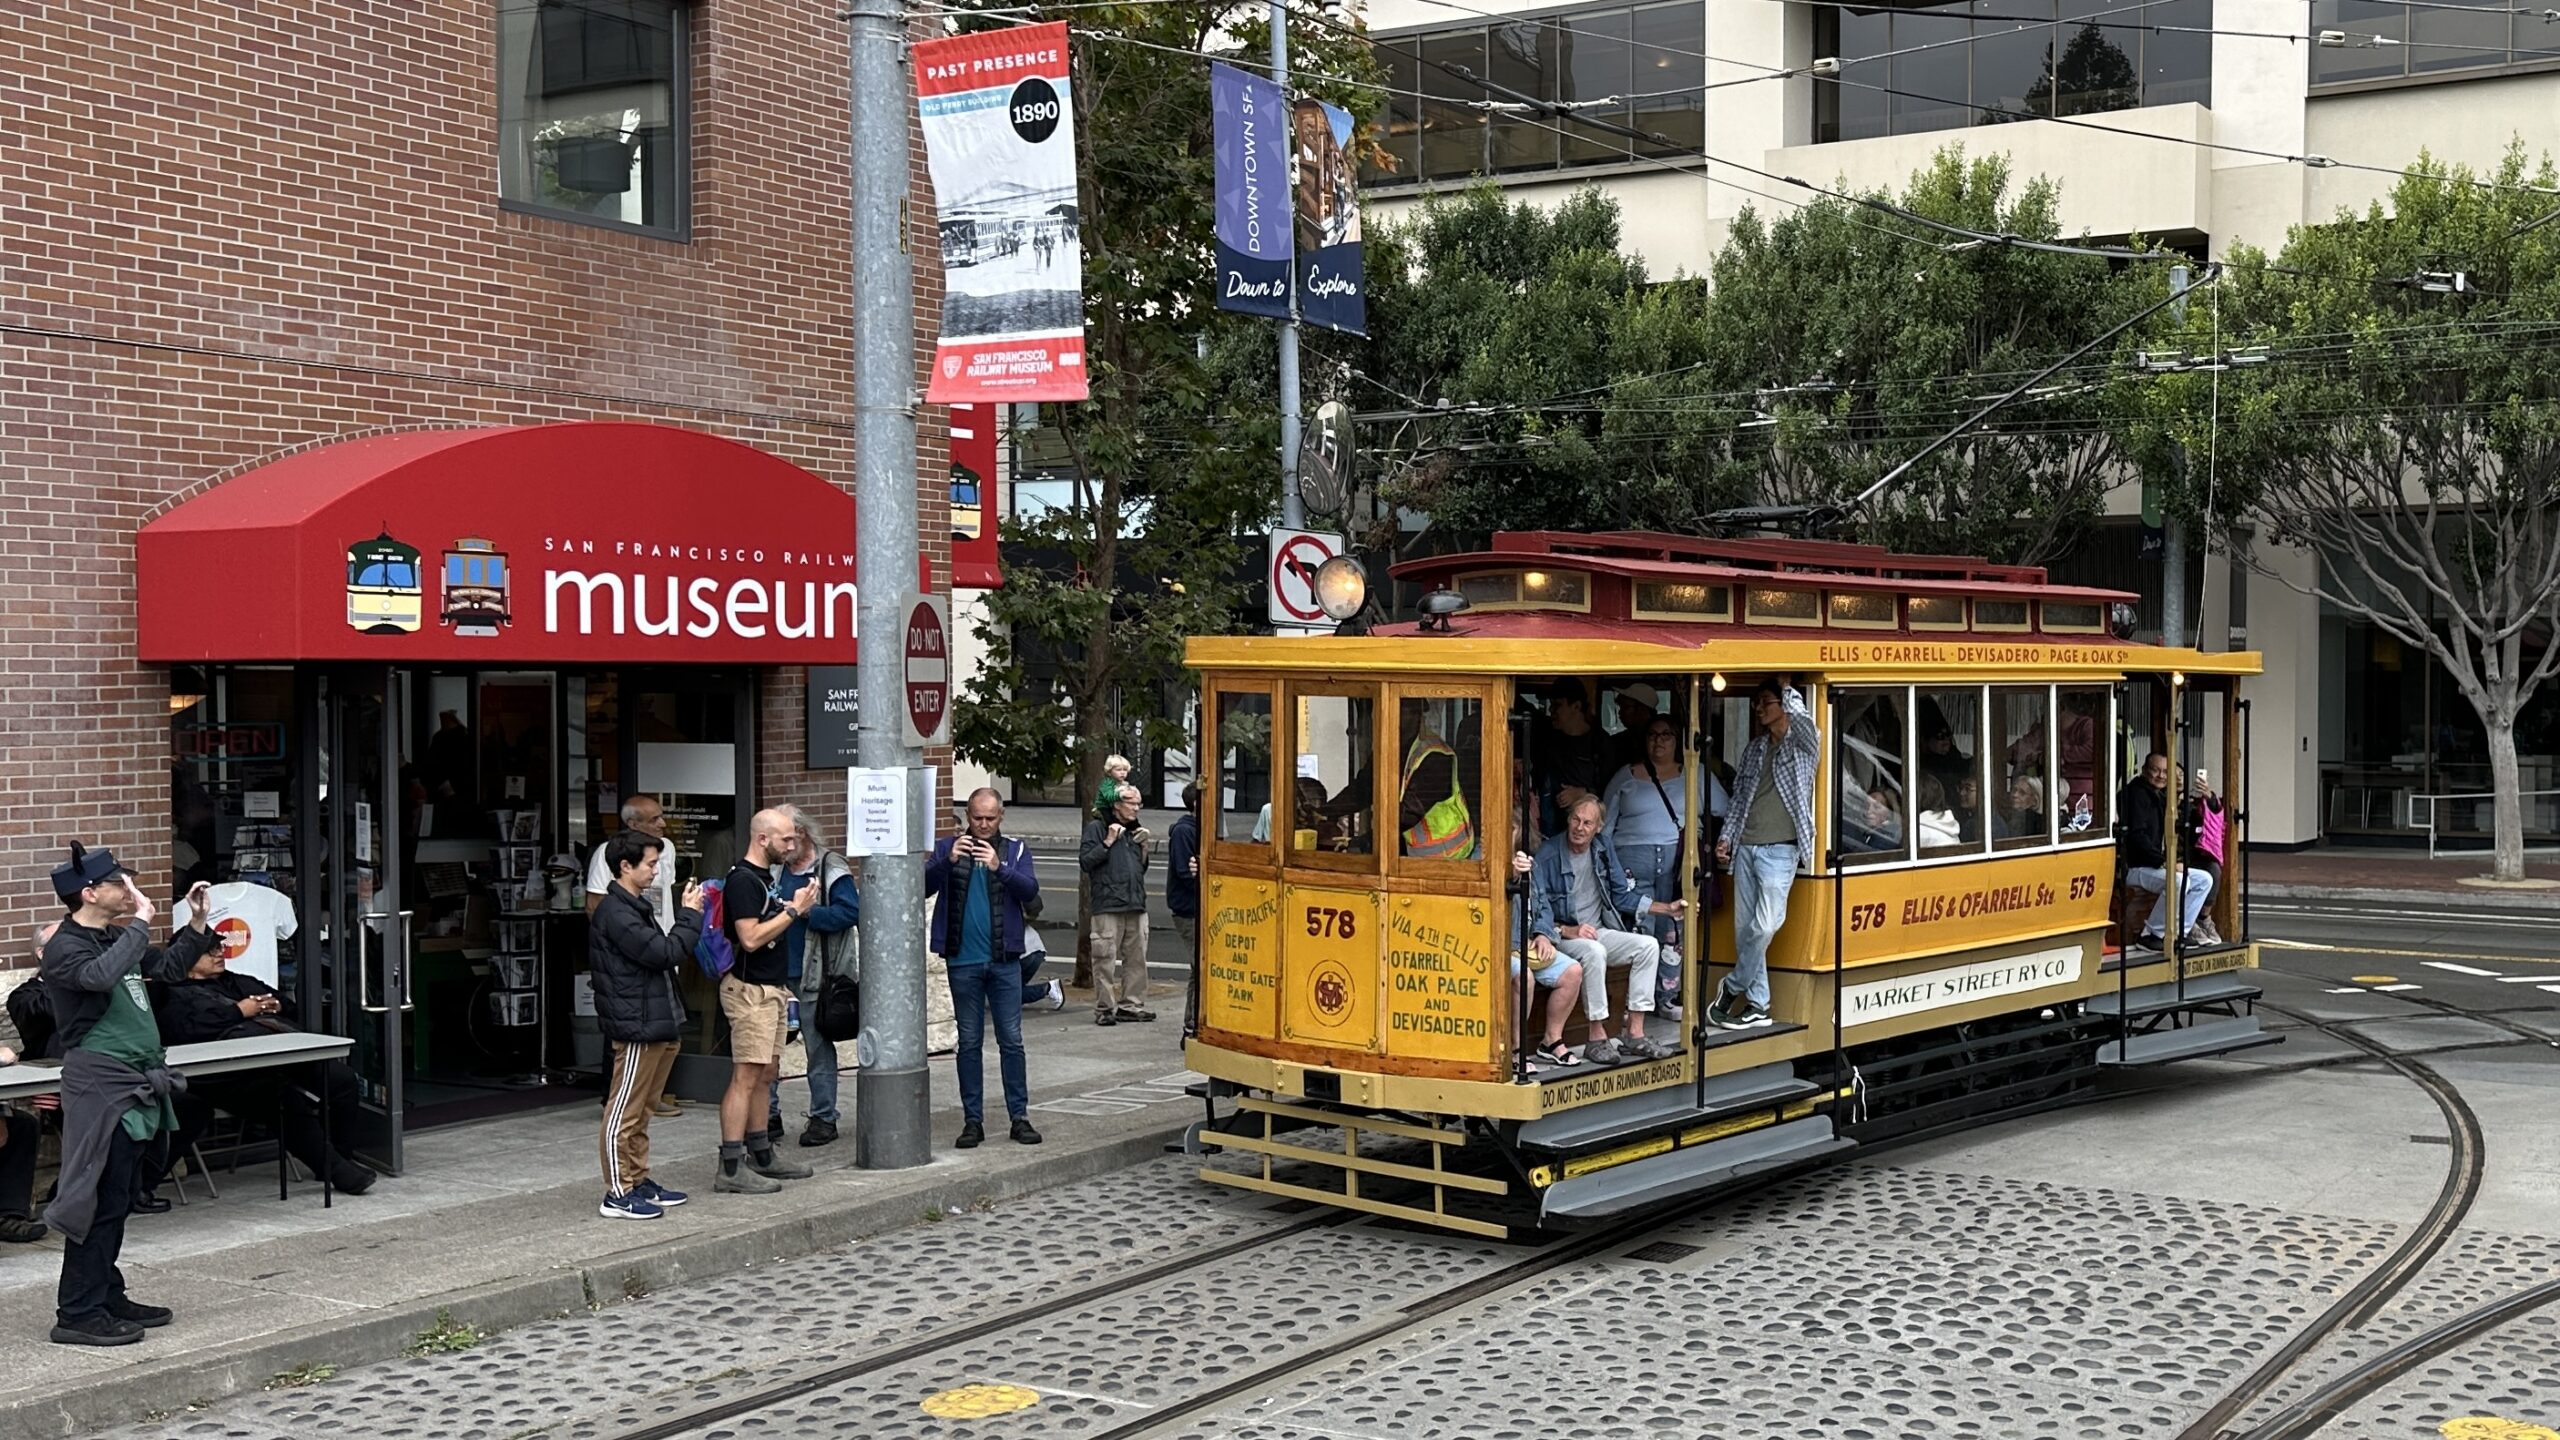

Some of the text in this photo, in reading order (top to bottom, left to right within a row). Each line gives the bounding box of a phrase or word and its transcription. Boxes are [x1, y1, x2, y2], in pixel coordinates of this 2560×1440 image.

[927, 49, 1059, 80] PAST PRESENCE
[1012, 100, 1058, 124] 1890
[1242, 120, 1260, 253] DOWNTOWN
[1226, 270, 1286, 298] Down to
[1308, 264, 1357, 299] Explore
[966, 361, 1054, 377] RAILWAY MUSEUM
[973, 353, 992, 365] SAN
[992, 349, 1047, 363] FRANCISCO
[544, 537, 855, 567] SAN FRANCISCO RAILW
[910, 627, 940, 652] DO NOT
[1820, 645, 1860, 662] ELLIS
[1872, 645, 1946, 662] O'FARRELL
[1957, 646, 2040, 663] DEVISADERO
[2050, 649, 2079, 663] PAGE
[2081, 651, 2089, 663] &
[2091, 649, 2114, 664] OAK
[824, 701, 859, 712] RAILWA
[827, 688, 848, 701] SAN
[914, 689, 940, 713] ENTER
[175, 727, 276, 755] OPEN
[2069, 874, 2095, 901] 578
[1850, 902, 1887, 932] 578
[1901, 895, 1946, 926] ELLIS
[1946, 896, 1956, 918] &
[1959, 884, 2032, 919] O'FARRELL
[1208, 898, 1277, 946] SOUTHERN PACIFIC
[1306, 906, 1355, 940] 578
[1225, 933, 1257, 951] DEPOT
[1392, 910, 1490, 975] VIA 4TH ELLIS
[1232, 952, 1249, 965] AND
[1390, 950, 1454, 973] O'FARRELL
[1210, 963, 1275, 988] GOLDEN GATE
[1396, 973, 1479, 998] OAK PAGE
[1227, 984, 1254, 1003] PARK
[1852, 982, 1936, 1014] MARKET
[1942, 968, 2014, 997] STREET
[1423, 998, 1450, 1012] AND
[1392, 1011, 1486, 1038] DEVISADERO
[1542, 1061, 1682, 1108] DO NOT STAND ON RUNNING BOARDS
